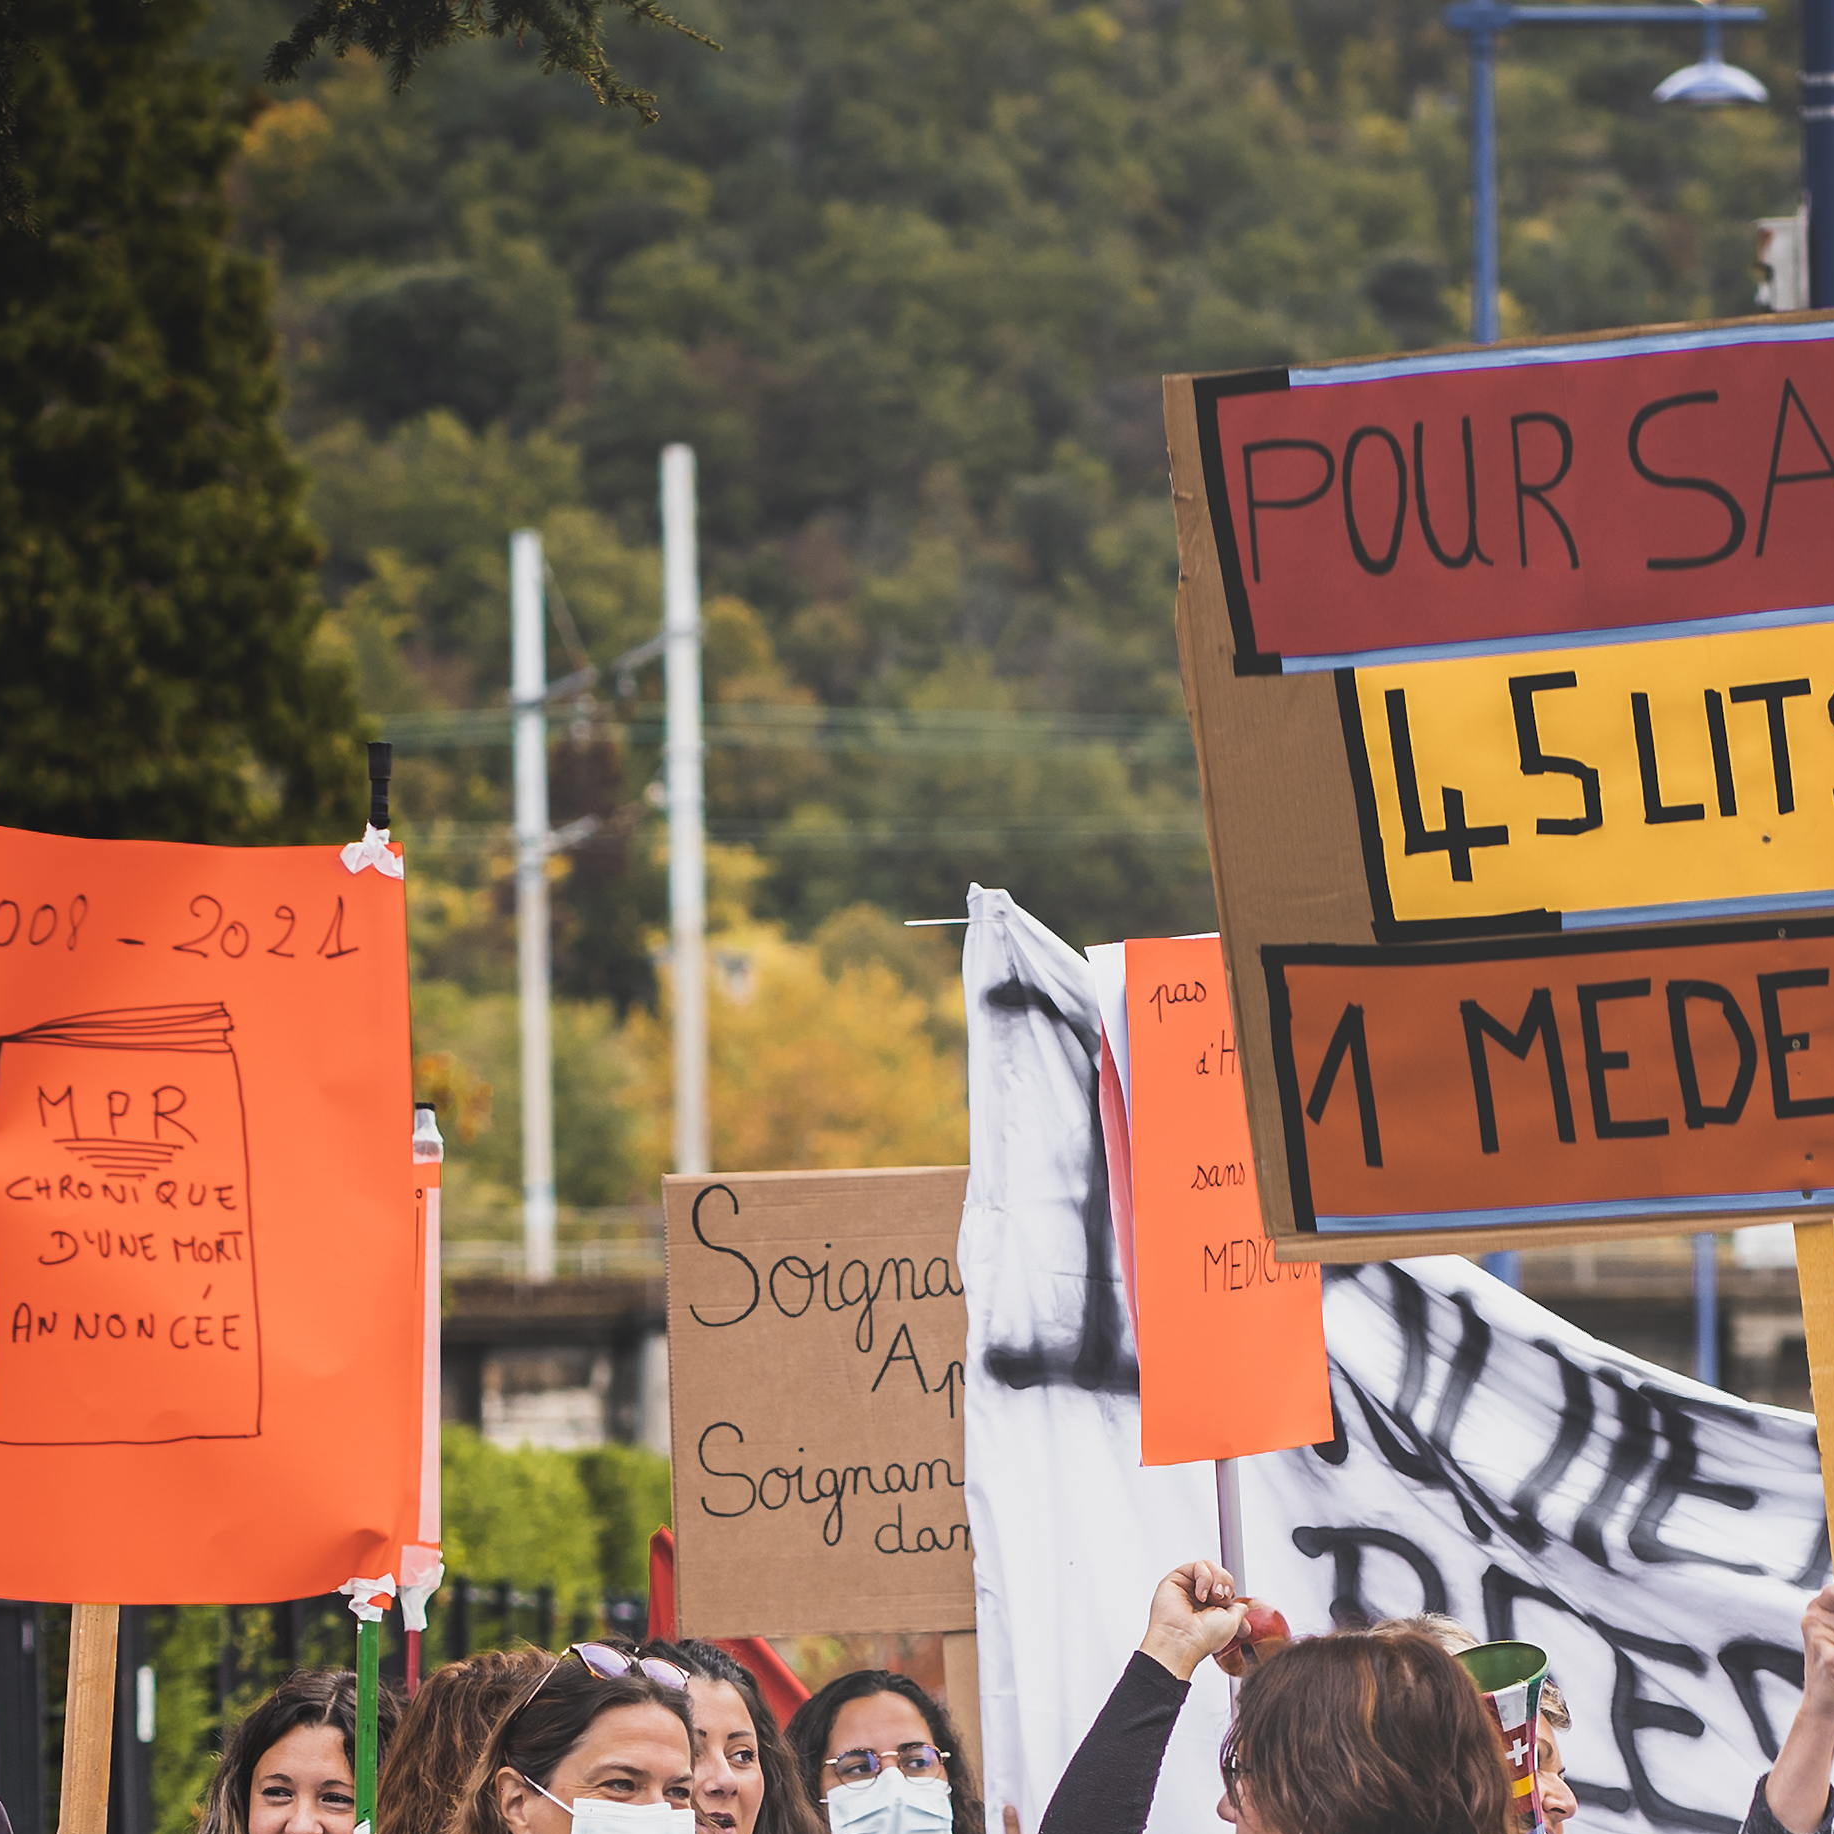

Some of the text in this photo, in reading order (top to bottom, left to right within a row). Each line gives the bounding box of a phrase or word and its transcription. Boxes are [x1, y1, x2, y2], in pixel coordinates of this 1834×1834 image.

[1243, 412, 1579, 584] POUR
[172, 894, 362, 960] 2021
[1150, 981, 1208, 1023] pas
[37, 1085, 199, 1144] MPR
[1306, 1002, 1383, 1168] 1
[1191, 1162, 1246, 1190] sans
[38, 1226, 246, 1267] D'UNE MORT
[11, 1282, 242, 1355] ANNONCÉE
